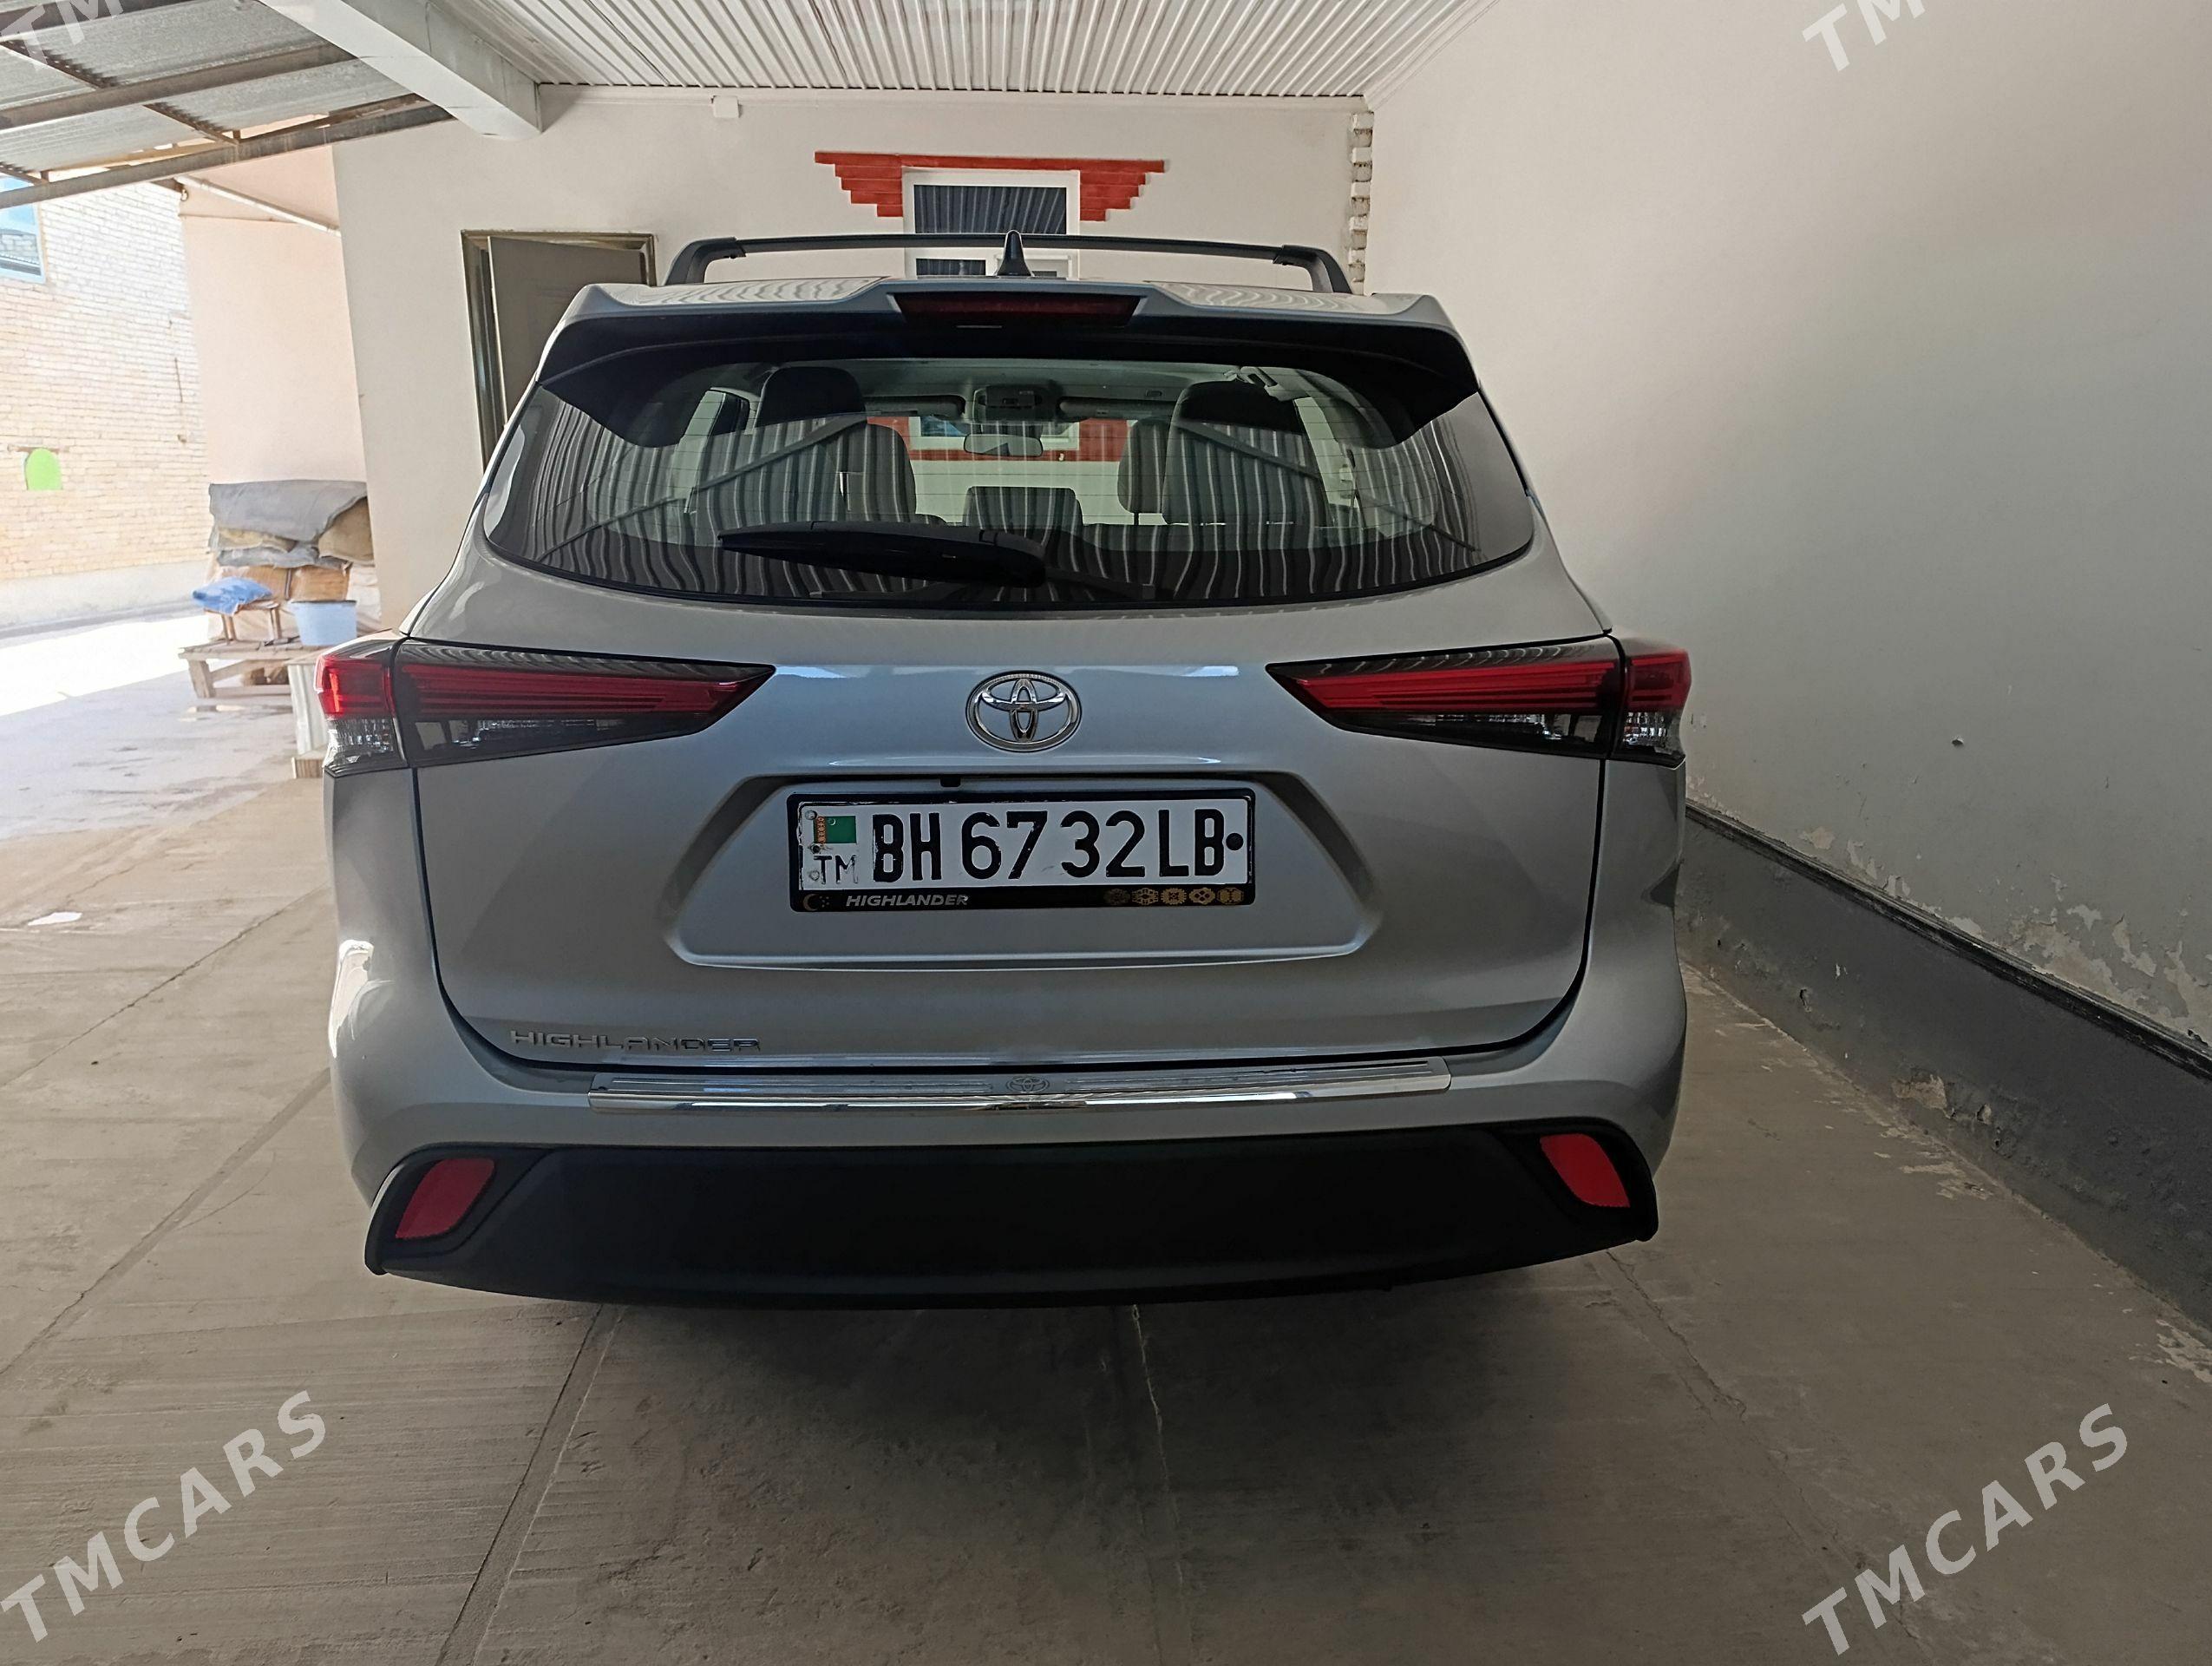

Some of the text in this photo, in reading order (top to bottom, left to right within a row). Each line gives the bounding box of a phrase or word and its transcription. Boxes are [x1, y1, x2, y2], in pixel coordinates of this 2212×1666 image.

[814, 855, 859, 884] TM
[846, 895, 969, 907] HIGHLANDER
[510, 1030, 761, 1052] HIGHLANDER
